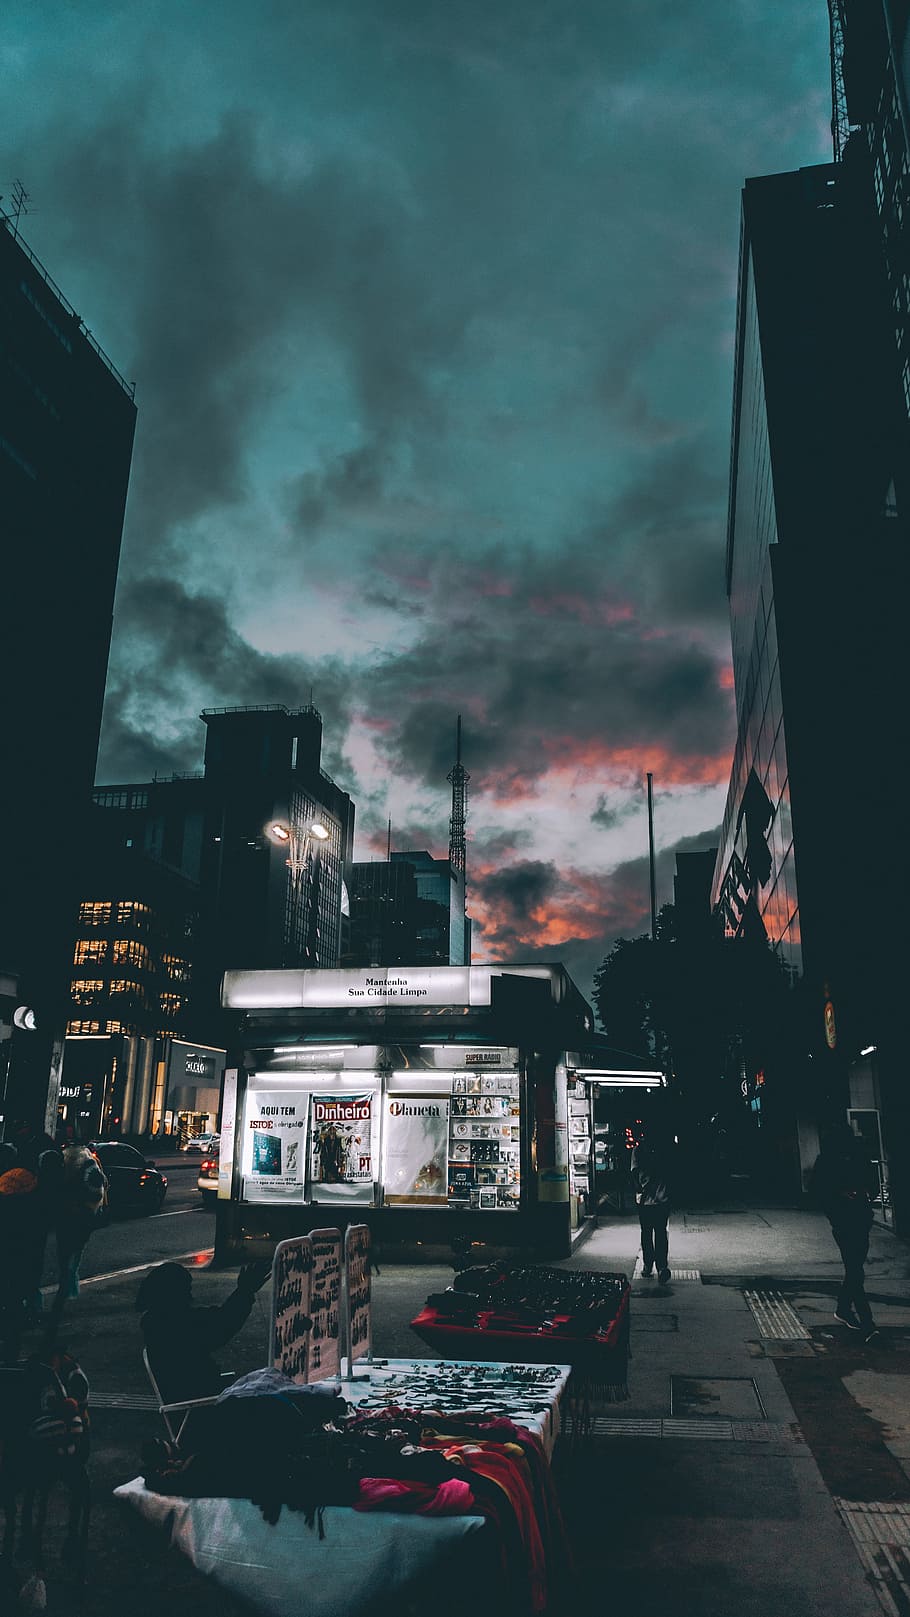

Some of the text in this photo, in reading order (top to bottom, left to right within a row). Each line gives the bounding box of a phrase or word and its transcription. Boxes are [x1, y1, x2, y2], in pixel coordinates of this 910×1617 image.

[365, 978, 408, 986] Mantenha
[348, 988, 427, 997] Sua Cidade Limpa
[465, 1053, 483, 1061] SUPER
[260, 1106, 296, 1116] AQUI TEM
[316, 1103, 370, 1120] Dinheiro
[390, 1102, 440, 1116] Planeta
[359, 1157, 371, 1171] PT
